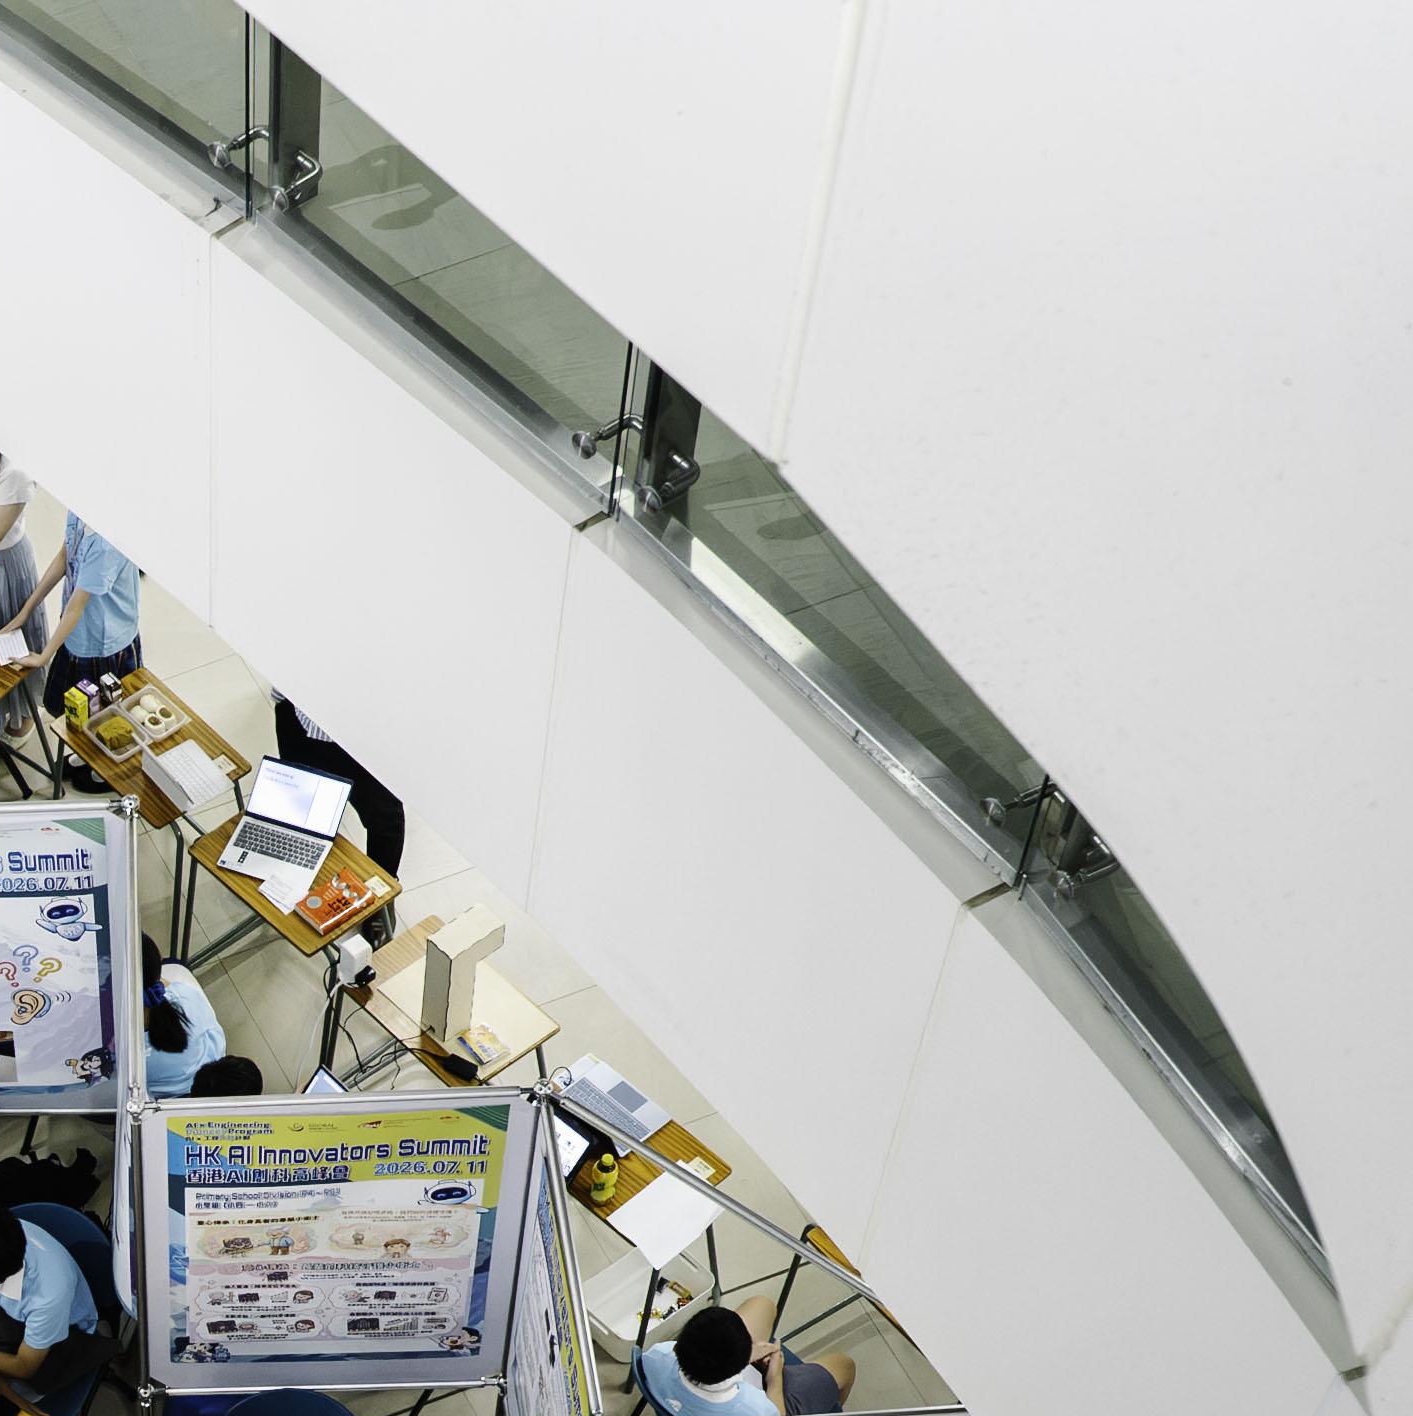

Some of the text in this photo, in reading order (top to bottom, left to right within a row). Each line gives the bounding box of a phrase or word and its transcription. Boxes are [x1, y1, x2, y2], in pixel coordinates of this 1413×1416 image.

[8, 850, 92, 873] Summit
[185, 1135, 490, 1165] HK AI Innovators Summit
[186, 1161, 487, 1183] 香港AI創科高峰會 2026.07.11
[195, 1191, 297, 1201] Primary School Division
